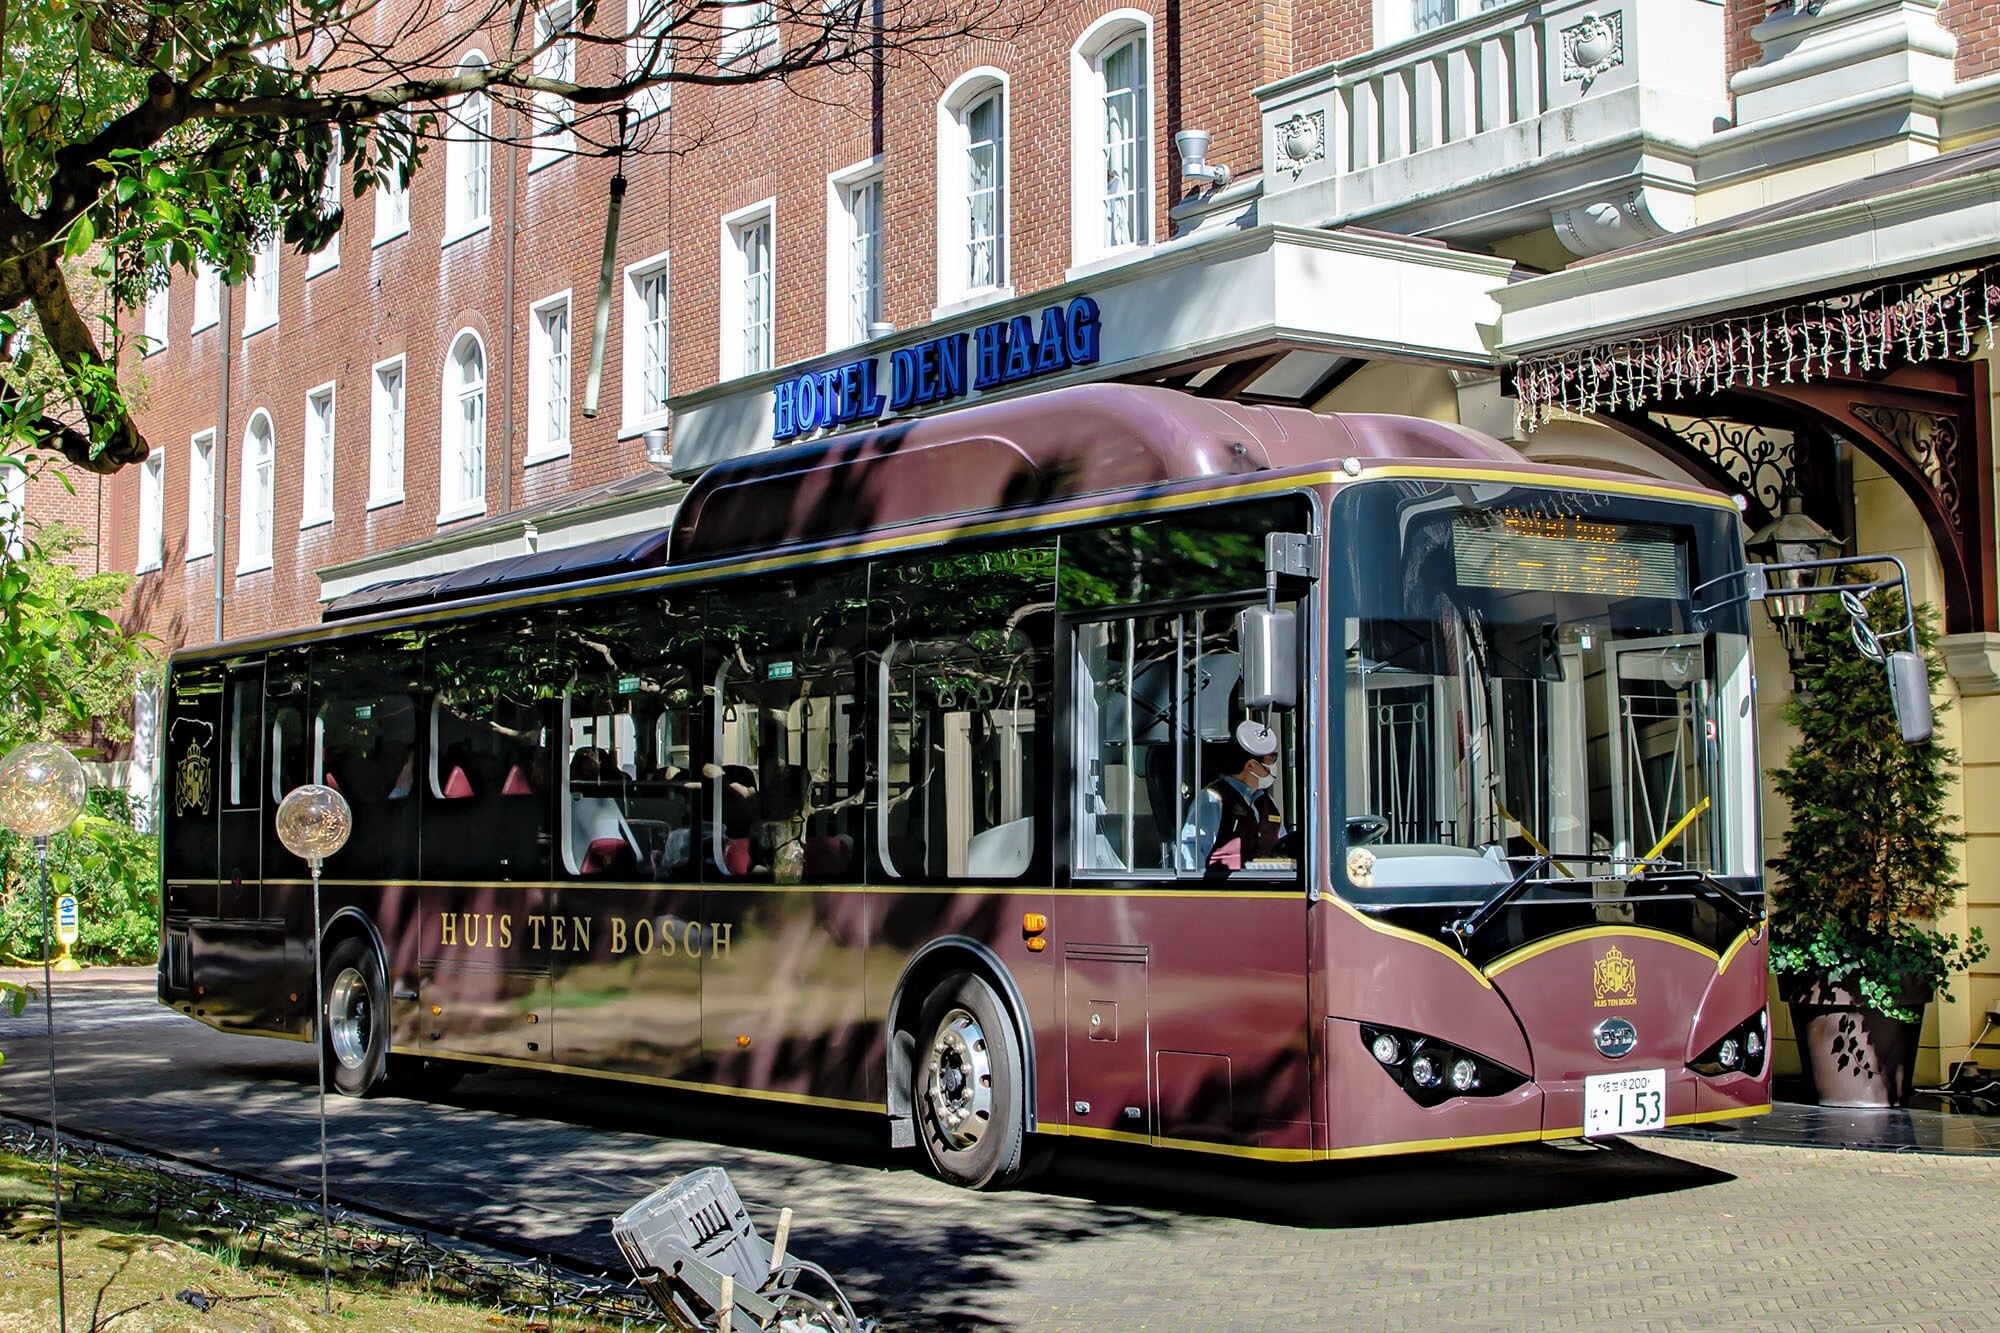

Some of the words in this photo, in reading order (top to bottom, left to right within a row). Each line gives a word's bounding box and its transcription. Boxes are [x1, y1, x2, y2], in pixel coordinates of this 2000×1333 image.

[773, 358, 886, 440] HOTEL
[889, 333, 968, 412] DEN
[974, 296, 1101, 390] HAAG
[440, 912, 512, 948] HUIS
[528, 915, 592, 951] TEN
[610, 917, 733, 960] BOSCH
